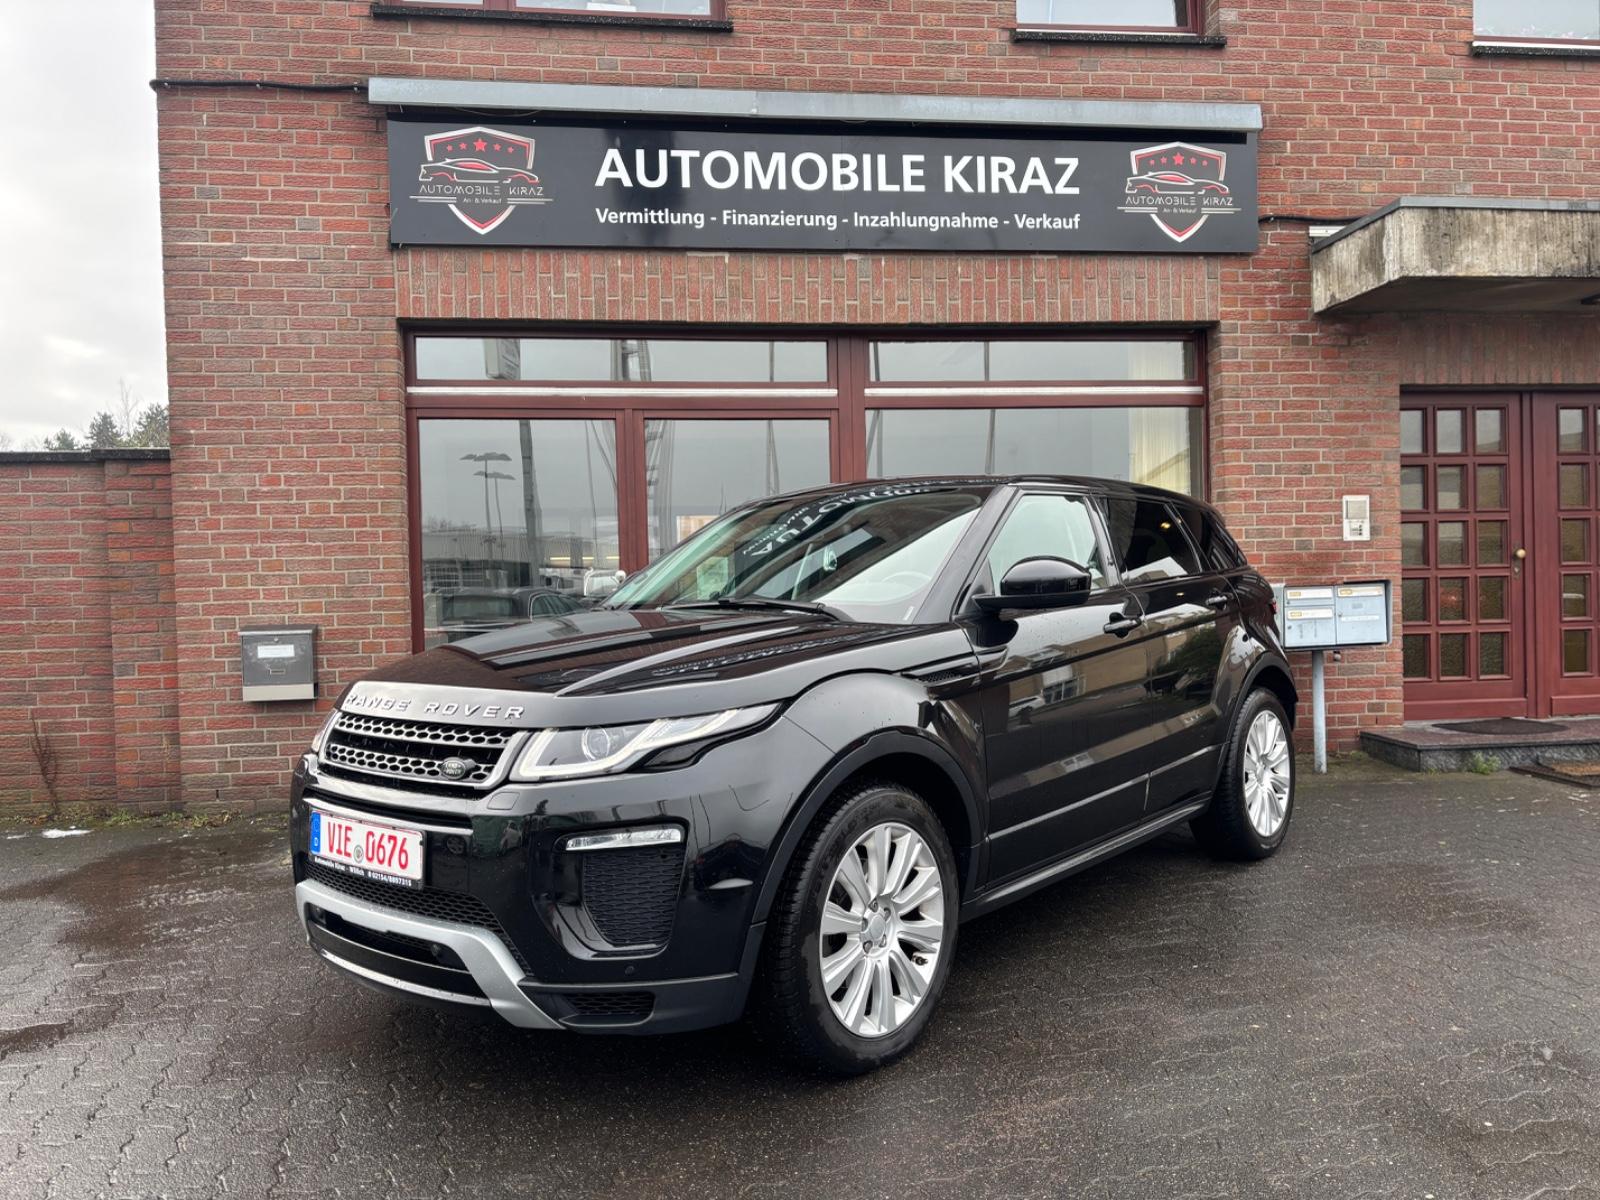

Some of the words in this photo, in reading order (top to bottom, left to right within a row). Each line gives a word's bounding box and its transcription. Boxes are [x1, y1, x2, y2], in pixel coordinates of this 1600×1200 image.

[594, 148, 926, 193] AUTOMOBILE
[943, 155, 1081, 195] KIRAZ
[419, 184, 501, 196] AUTOMOBILE
[509, 186, 544, 196] KIRAZ
[1125, 195, 1197, 206] AUTOMOBILE
[1202, 196, 1233, 206] KIRAZ
[595, 207, 705, 229] Vermittlung
[722, 208, 838, 231] Finanzierung
[853, 211, 999, 232] Inzahlungnahme
[1013, 212, 1081, 230] Verkauf
[345, 694, 411, 712] RANGE
[424, 702, 525, 719] ROVER
[327, 821, 353, 858] VIE
[365, 831, 409, 870] 0676
